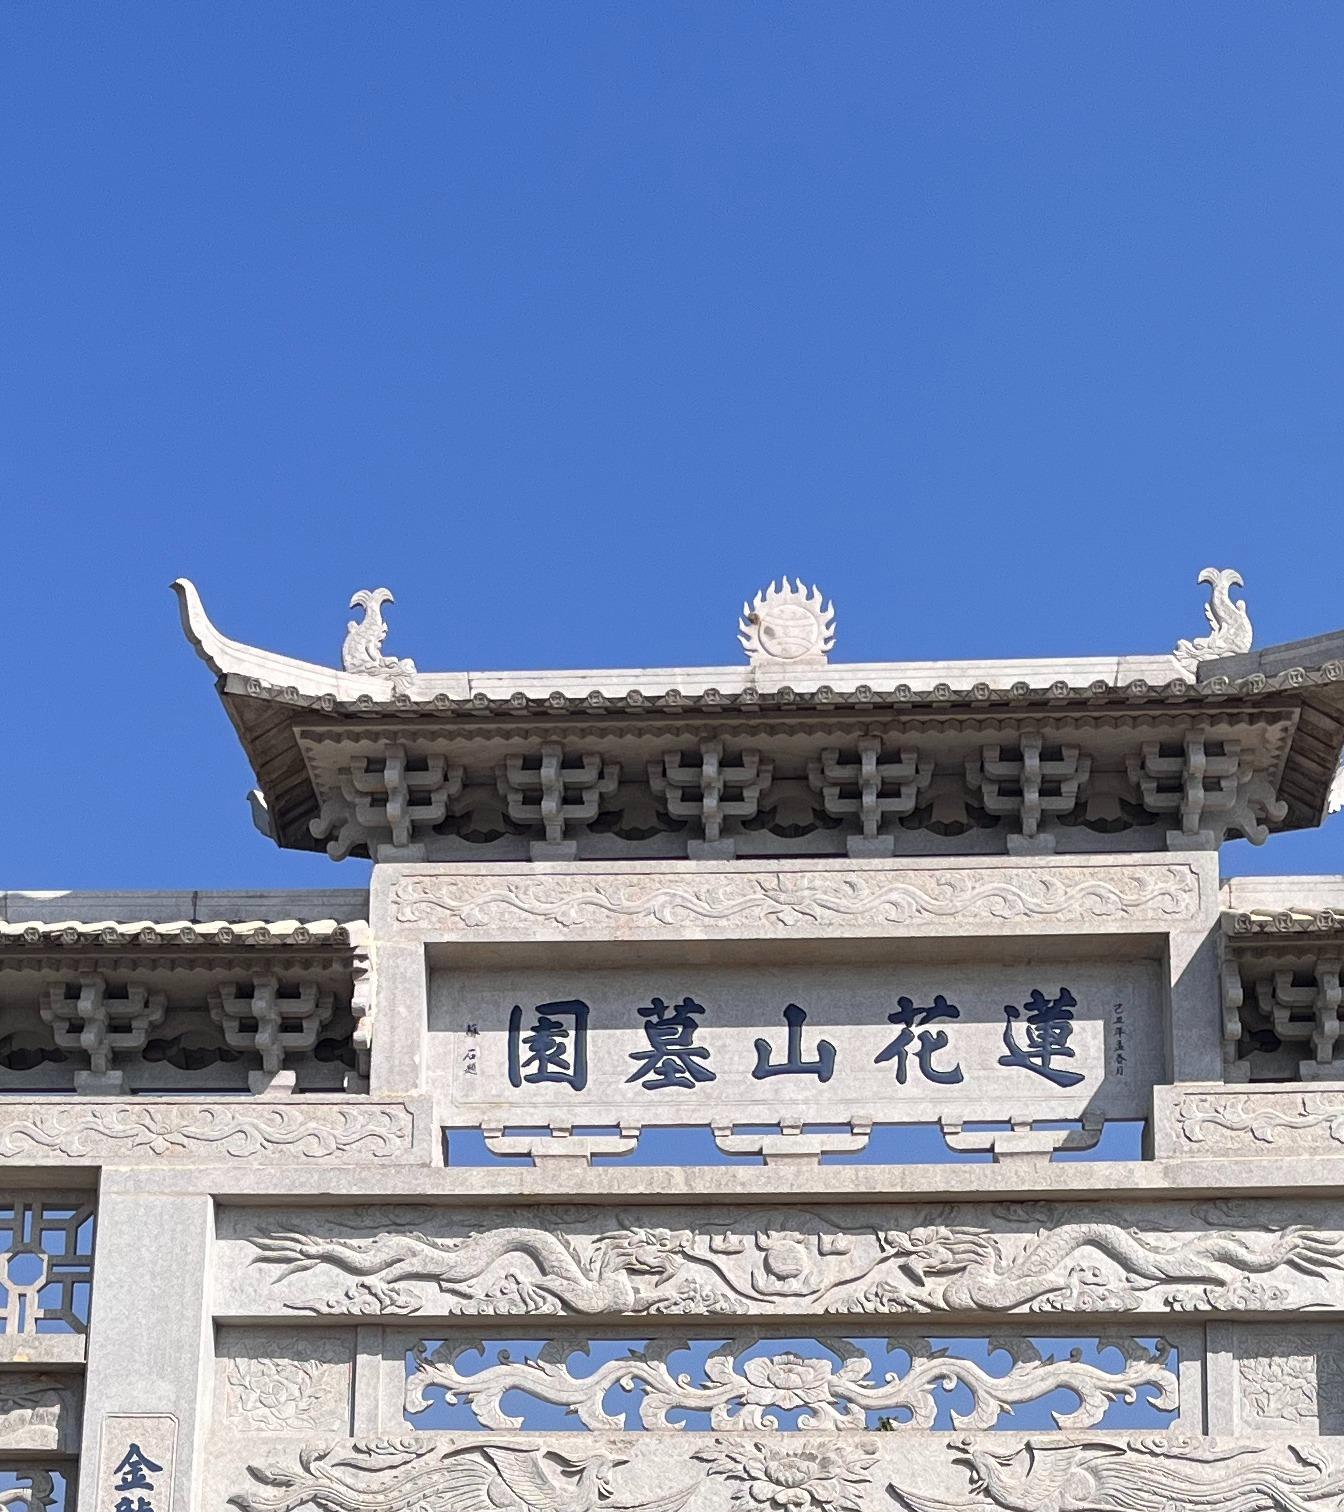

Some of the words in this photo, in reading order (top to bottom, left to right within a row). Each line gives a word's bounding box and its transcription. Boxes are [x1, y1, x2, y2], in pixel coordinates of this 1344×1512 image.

[508, 986, 1086, 1092] 蓮花山墓園
